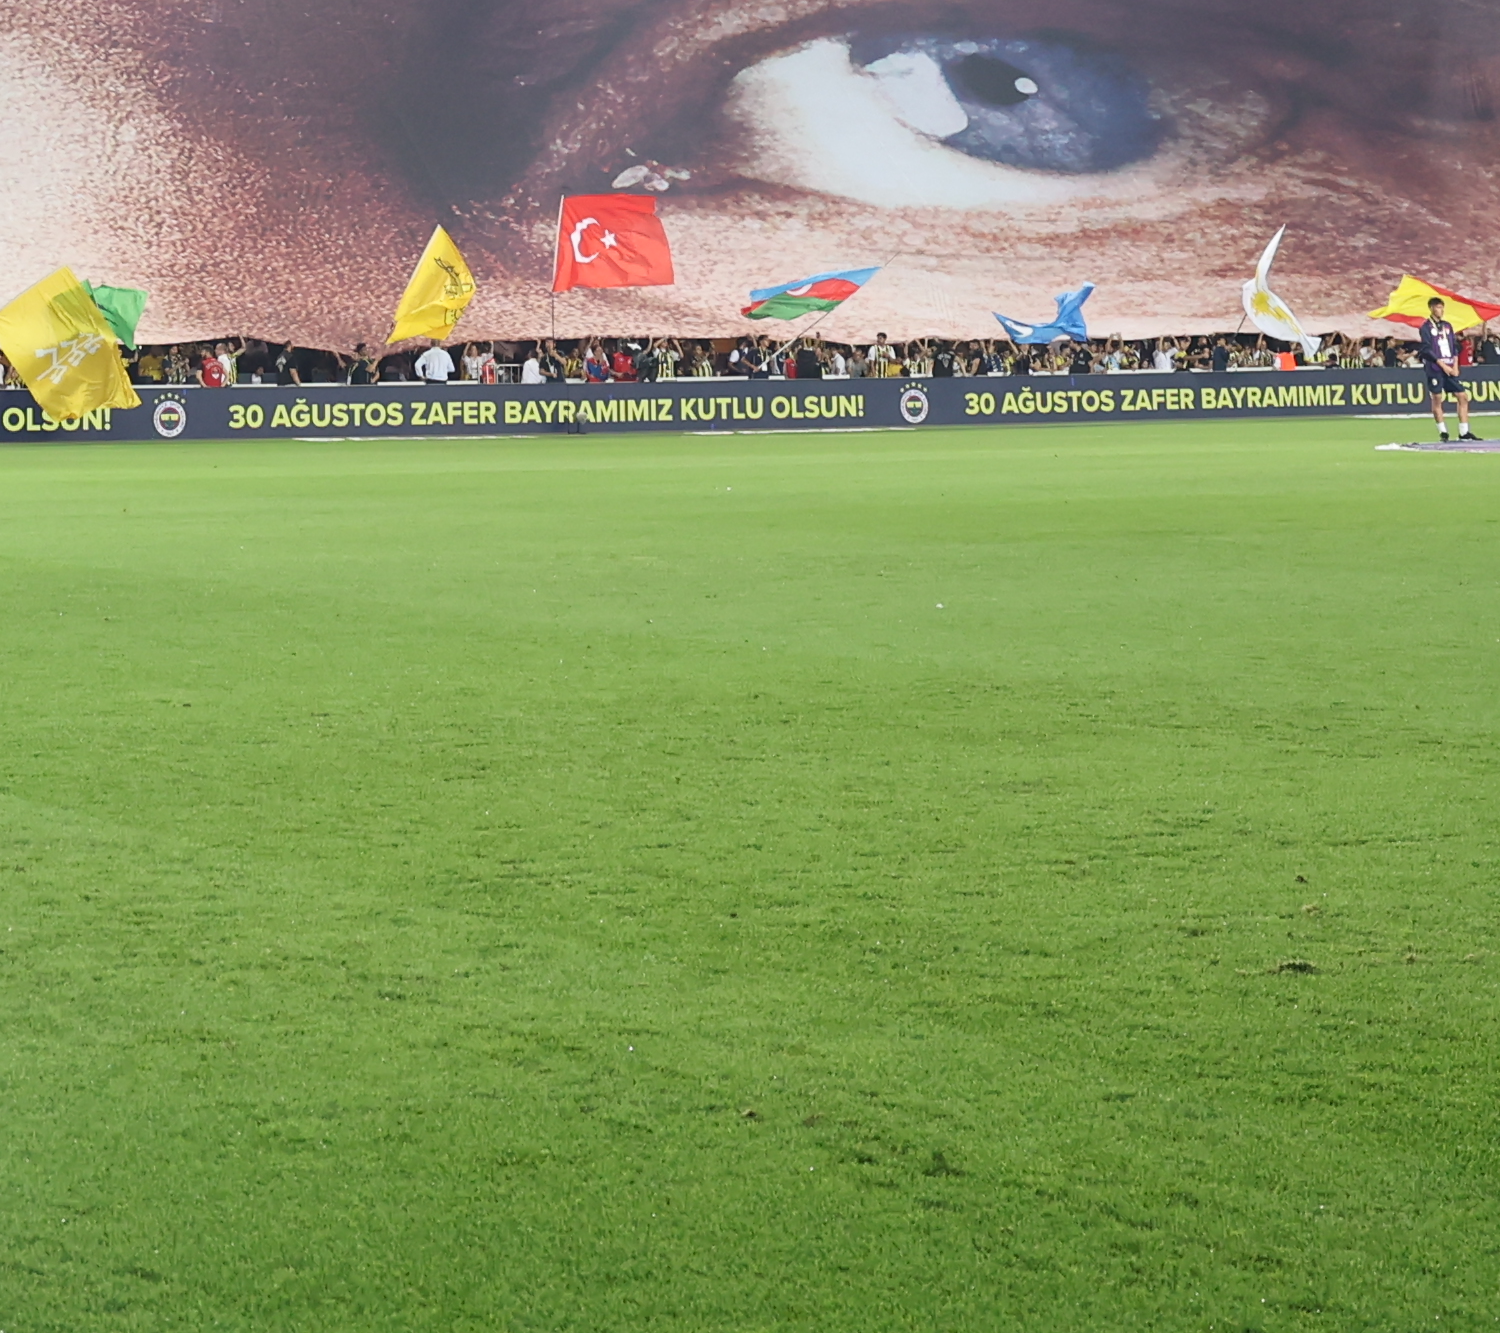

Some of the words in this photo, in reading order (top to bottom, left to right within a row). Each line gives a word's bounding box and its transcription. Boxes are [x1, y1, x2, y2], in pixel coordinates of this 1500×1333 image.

[228, 404, 264, 429] 30
[270, 398, 405, 429] AĞUSTOS
[411, 400, 497, 426] ZAFER
[503, 397, 674, 425] BAYRAMIMIZ
[680, 396, 764, 422] KUTLU
[770, 394, 865, 420] OLSUN!
[964, 391, 995, 416] 30
[1001, 385, 1115, 415] AĞUSTOS
[1120, 388, 1195, 412] ZAFER
[1201, 384, 1345, 410] BAYRAMIMIZ
[1351, 382, 1424, 406] KUTLU
